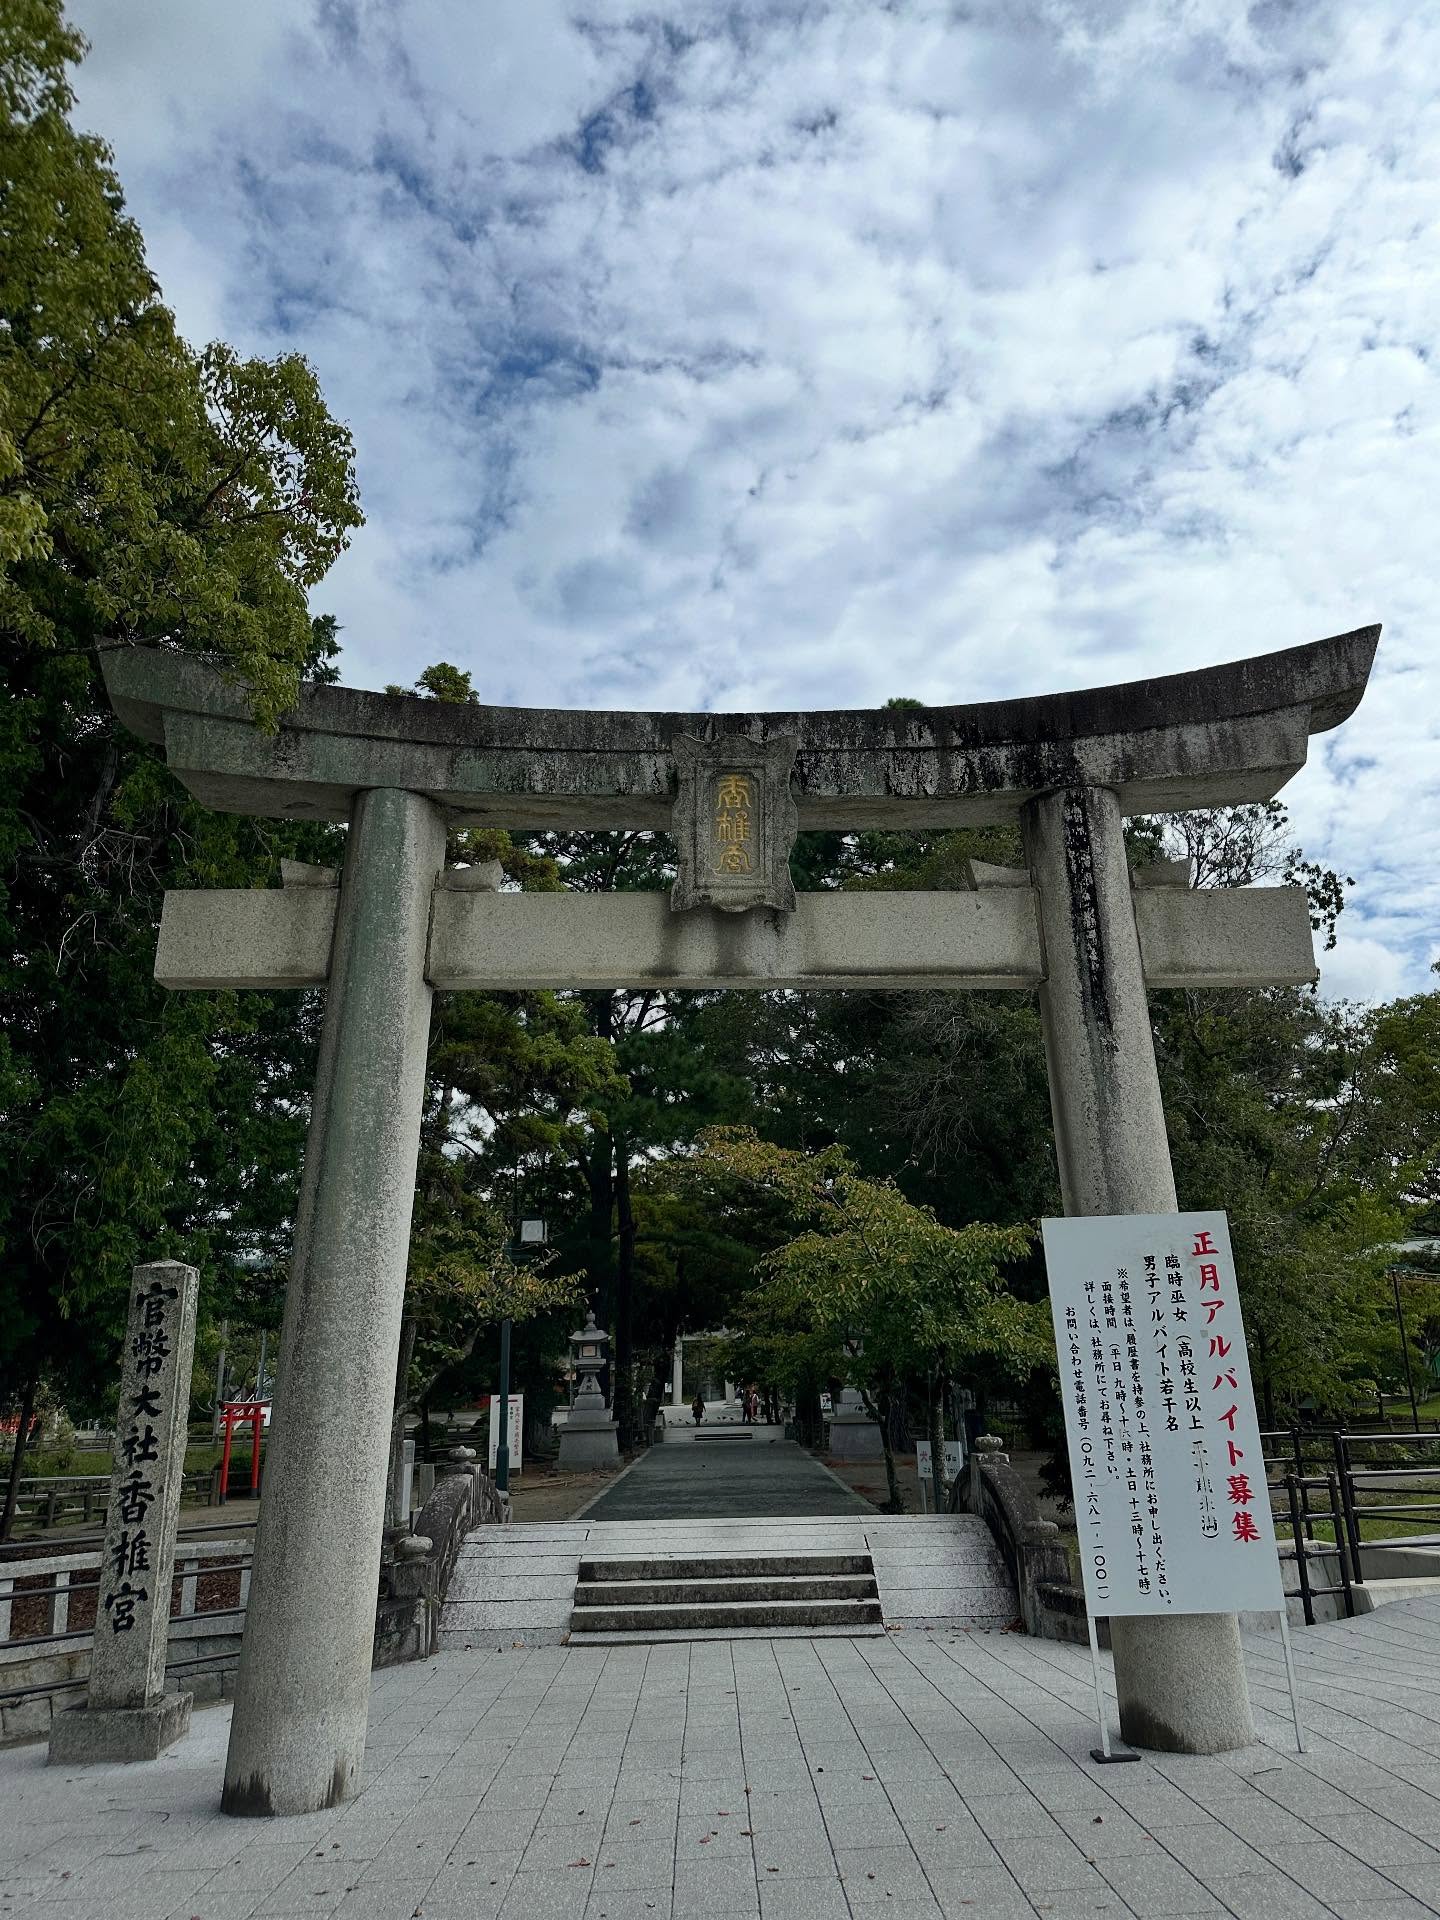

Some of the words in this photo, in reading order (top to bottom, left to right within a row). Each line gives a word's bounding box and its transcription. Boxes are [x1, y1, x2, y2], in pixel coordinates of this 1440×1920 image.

[712, 773, 752, 873] 香椎宮
[1083, 1280, 1120, 1481] 詳しくは、社務所にてお尋ね下さい。
[1143, 1255, 1179, 1432] 男子アルバイト若干名
[1191, 1231, 1261, 1543] 正月アルバイト募集
[104, 1281, 178, 1633] 官幣大社香椎宮
